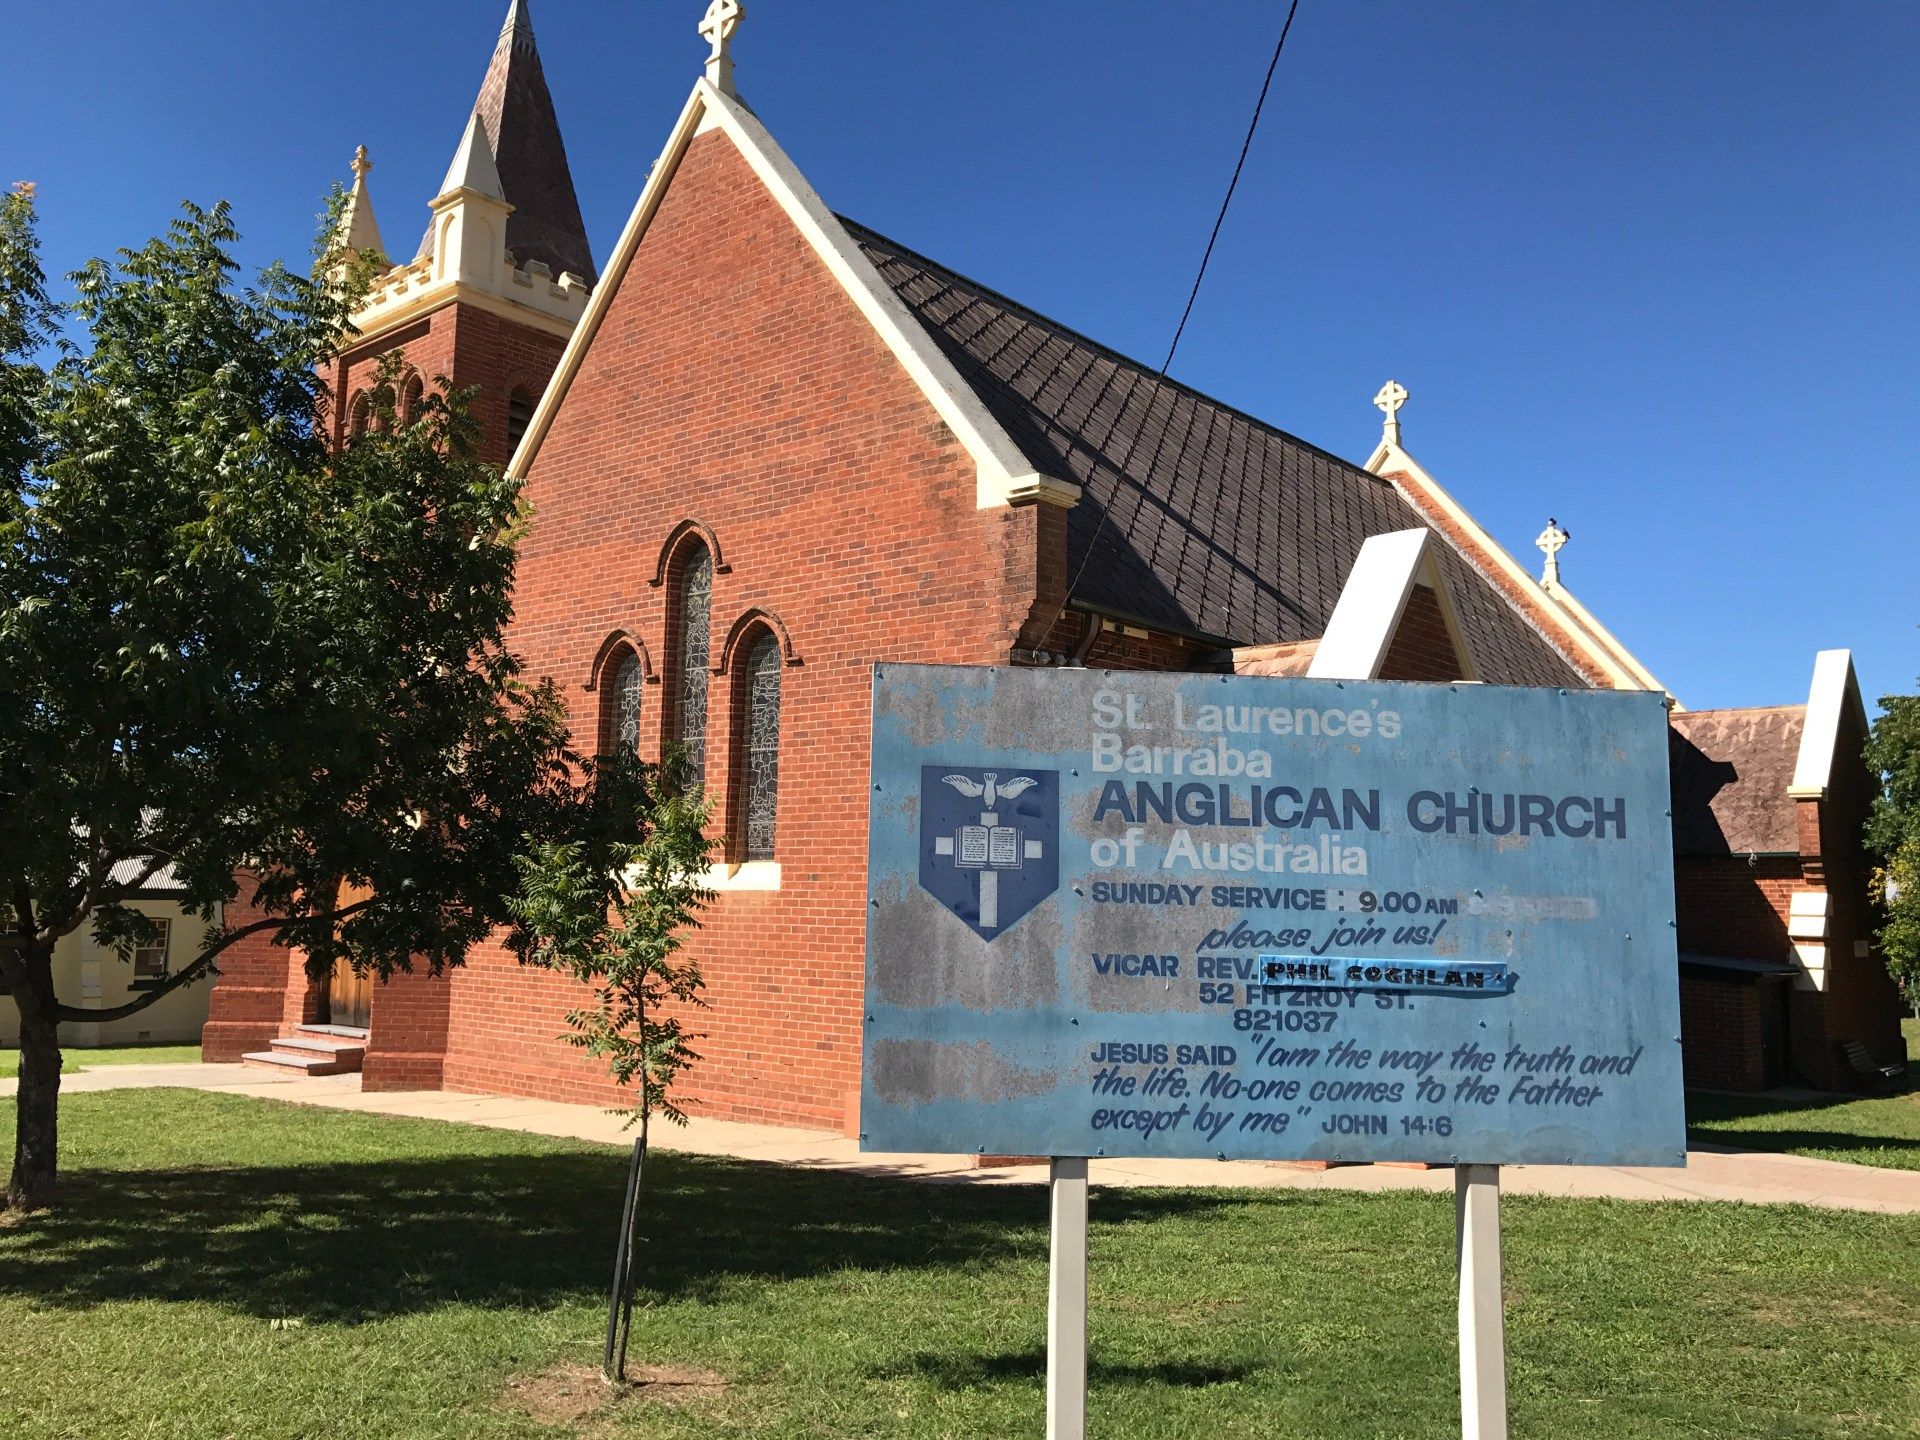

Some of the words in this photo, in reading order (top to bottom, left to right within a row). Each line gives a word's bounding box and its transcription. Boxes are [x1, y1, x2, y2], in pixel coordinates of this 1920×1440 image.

[1174, 692, 1401, 738] Laurence's
[1092, 732, 1272, 778] Barraba
[1093, 780, 1380, 831] ANGLICAN
[1407, 790, 1626, 839] CHURCH
[1090, 828, 1144, 868] of
[1163, 829, 1367, 875] Australia
[1092, 882, 1203, 906] SUNDAY
[1196, 919, 1311, 953] please
[1310, 917, 1387, 956] join
[1392, 918, 1447, 946] us!
[1092, 953, 1178, 977] VICAR
[1197, 957, 1257, 979] REV.
[1267, 961, 1336, 981] PHIL
[1199, 982, 1235, 1005] 52
[1246, 984, 1362, 1008] FITZROY
[1374, 989, 1415, 1010] ST.
[1233, 1009, 1338, 1032] 821037
[1091, 1042, 1169, 1066] JESUS
[1176, 1044, 1237, 1066] SAID
[1268, 1048, 1321, 1069] am
[1324, 1038, 1373, 1070] the
[1378, 1049, 1444, 1079] way
[1450, 1041, 1496, 1073] the
[1502, 1043, 1576, 1074] truth
[1578, 1045, 1645, 1076] and
[1091, 1065, 1135, 1098] the
[1141, 1066, 1192, 1099] life.
[1199, 1069, 1301, 1101] No-one
[1308, 1078, 1405, 1104] comes
[1415, 1074, 1447, 1104] to
[1453, 1074, 1501, 1105] the
[1508, 1075, 1604, 1107] Father
[1091, 1102, 1191, 1142] except
[1192, 1101, 1235, 1143] by
[1321, 1114, 1388, 1136] JOHN
[1400, 1114, 1454, 1137] 14:6
